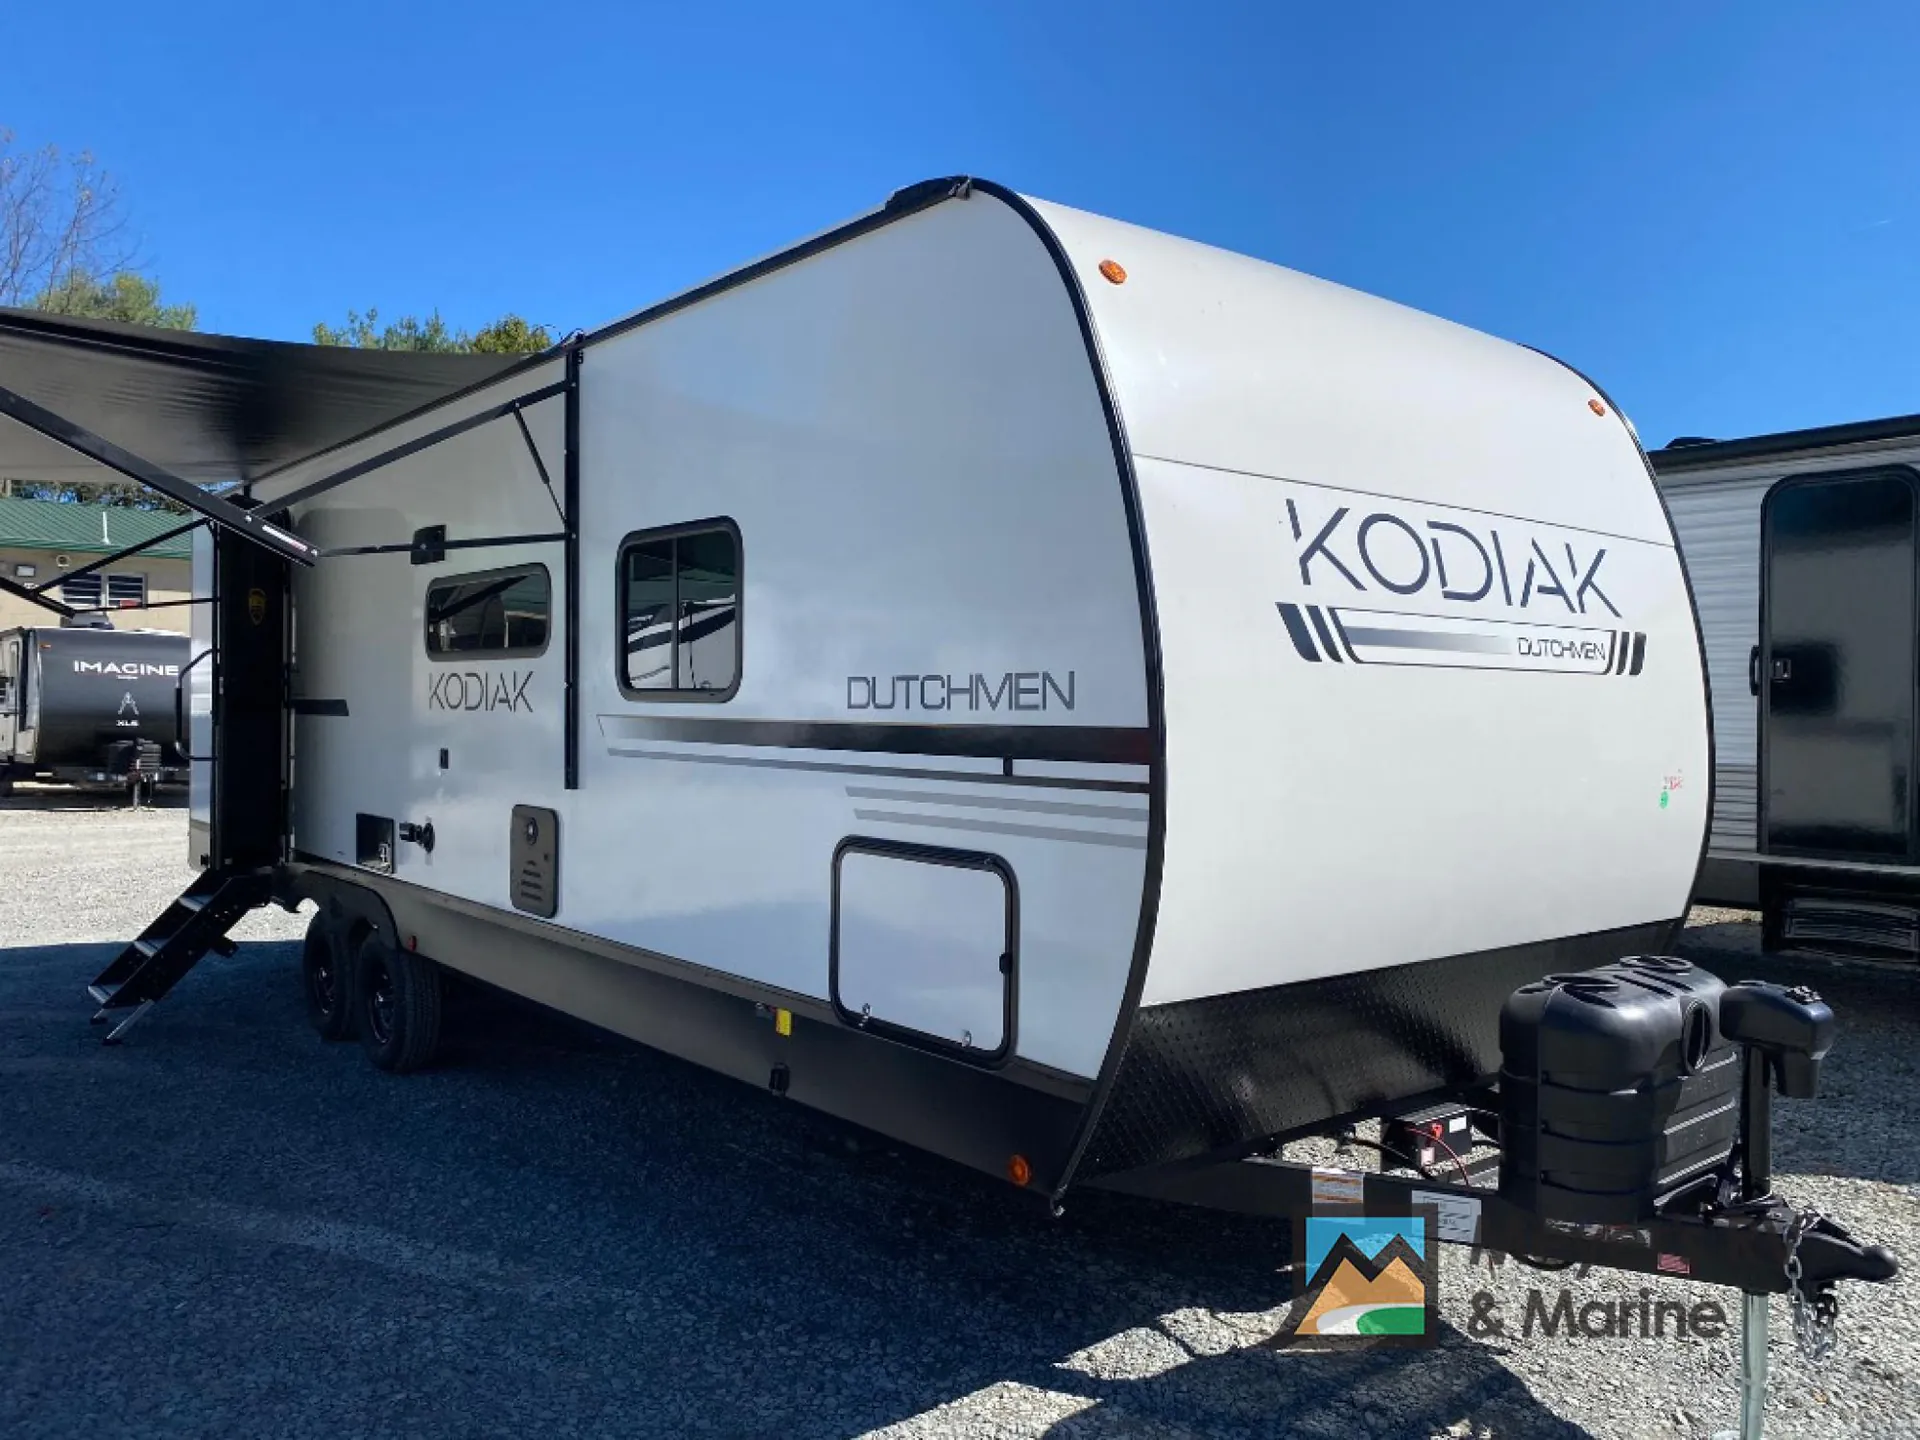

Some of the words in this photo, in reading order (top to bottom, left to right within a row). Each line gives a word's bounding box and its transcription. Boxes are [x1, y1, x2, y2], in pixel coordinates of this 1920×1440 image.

[1286, 498, 1622, 618] KODIAK
[74, 659, 180, 677] IMAGINE
[1517, 636, 1606, 661] DUTCHMEN
[428, 670, 534, 713] KODIAK
[846, 671, 1076, 711] DUTCHMEN
